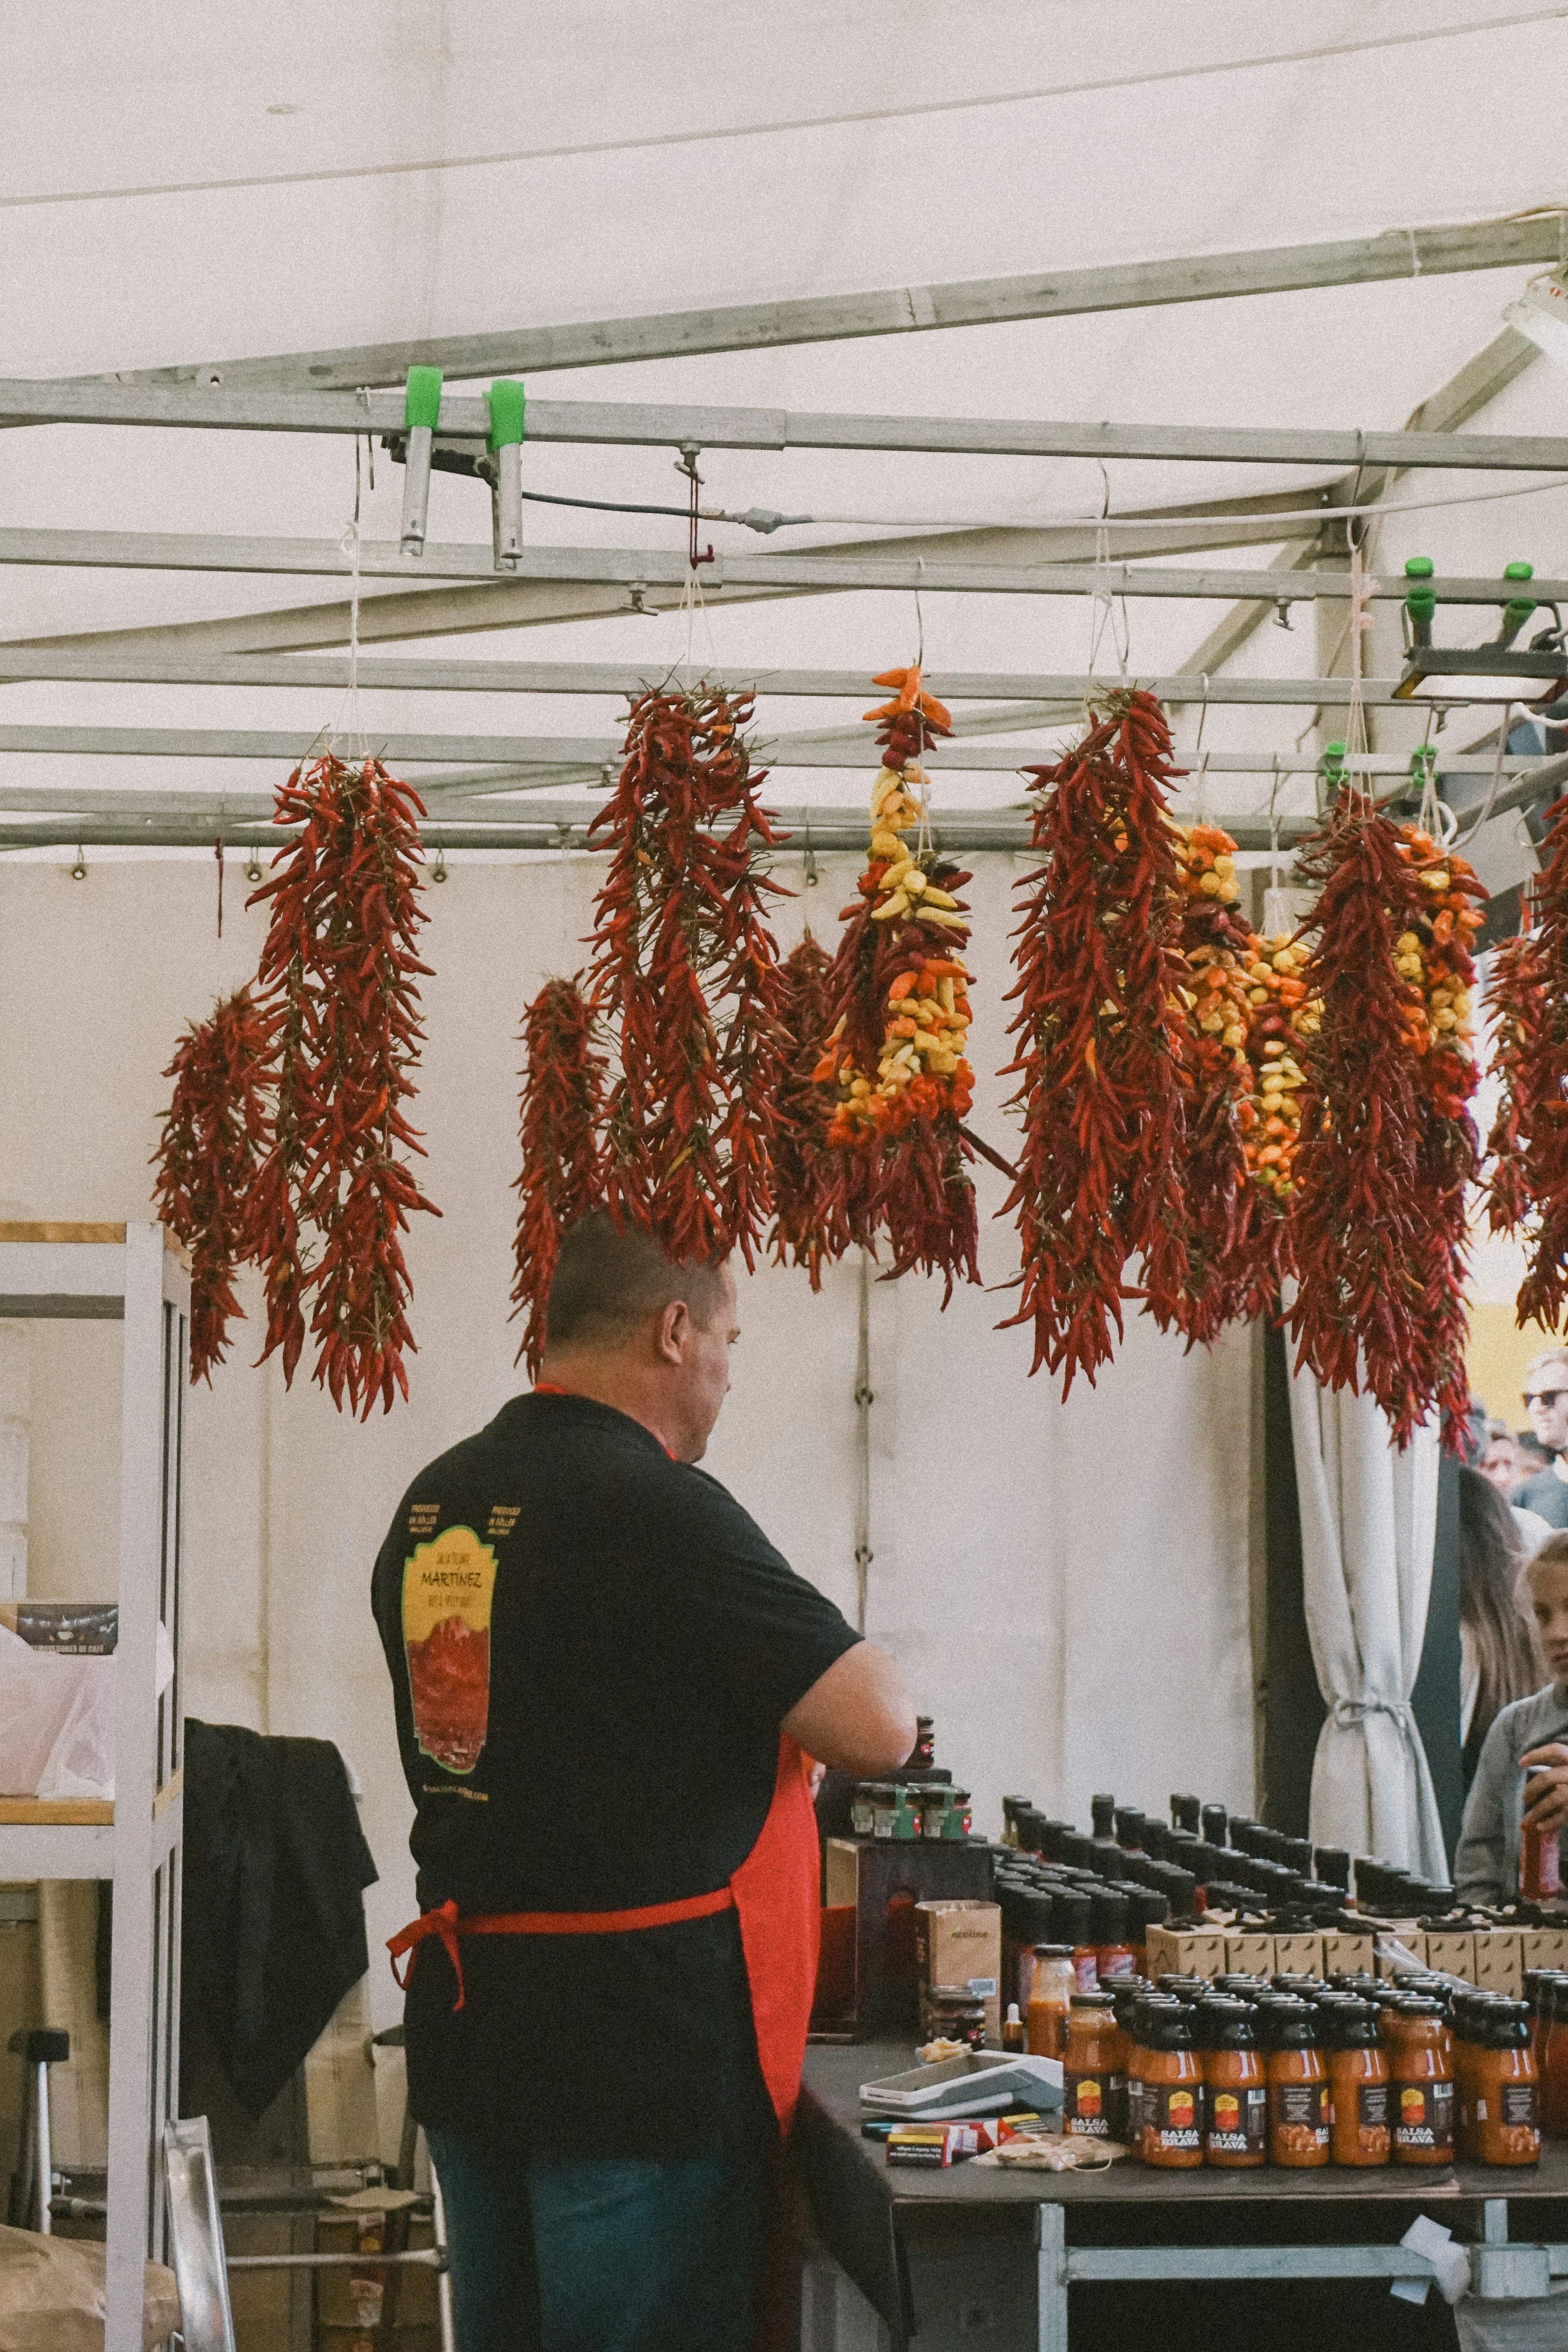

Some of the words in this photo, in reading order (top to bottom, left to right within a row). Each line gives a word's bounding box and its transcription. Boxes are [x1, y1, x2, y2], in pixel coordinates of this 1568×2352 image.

[1071, 2118, 1109, 2126] SALSA
[1161, 2130, 1199, 2138] SALSA
[1161, 2138, 1199, 2146] BRAVA
